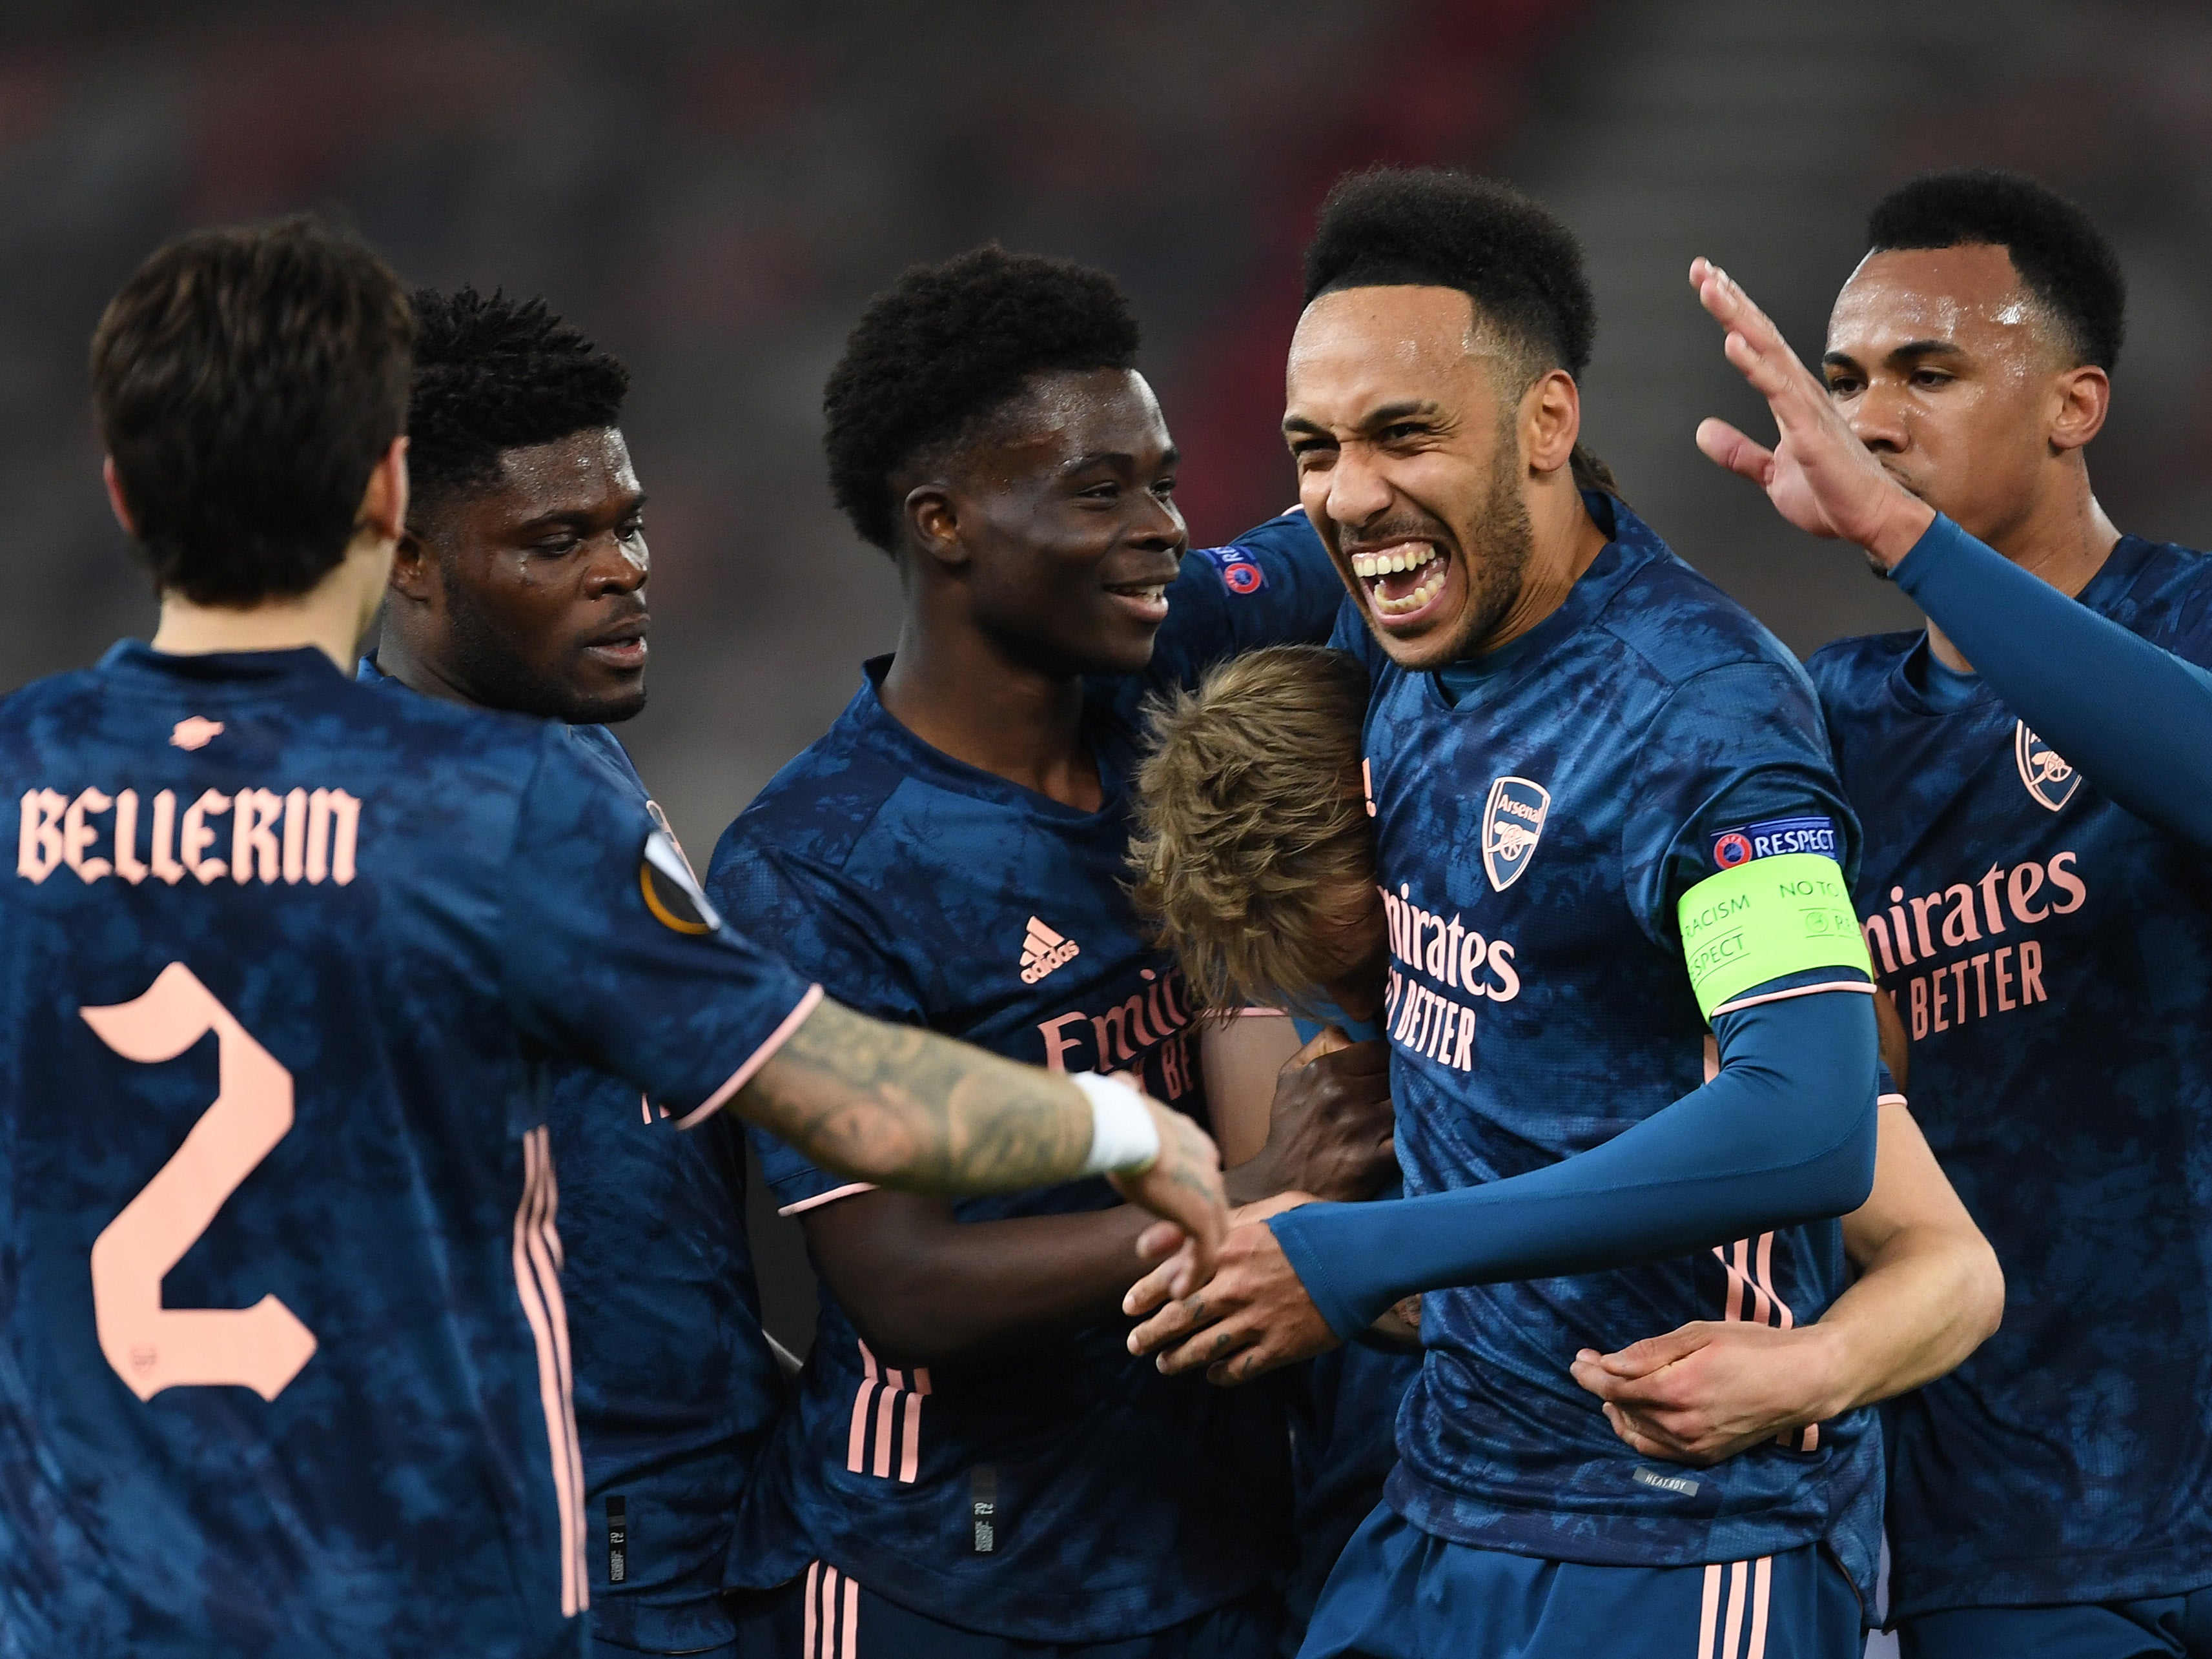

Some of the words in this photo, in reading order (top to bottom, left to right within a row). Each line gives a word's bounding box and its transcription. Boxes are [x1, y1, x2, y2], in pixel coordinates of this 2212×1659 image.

[18, 786, 362, 886] BELLERIN
[1497, 794, 1544, 824] Arsenal
[1754, 829, 1835, 859] RESPECT
[1779, 881, 1813, 899] NO
[1816, 881, 1839, 897] TO
[1020, 939, 1081, 984] adidas
[1376, 882, 1521, 1003] mirates
[1689, 933, 1744, 982] ESPECT
[1037, 966, 1192, 1074] Emir
[1393, 979, 1477, 1072] BETTER
[1909, 940, 2048, 1041] BETTER
[79, 961, 318, 1402] 2
